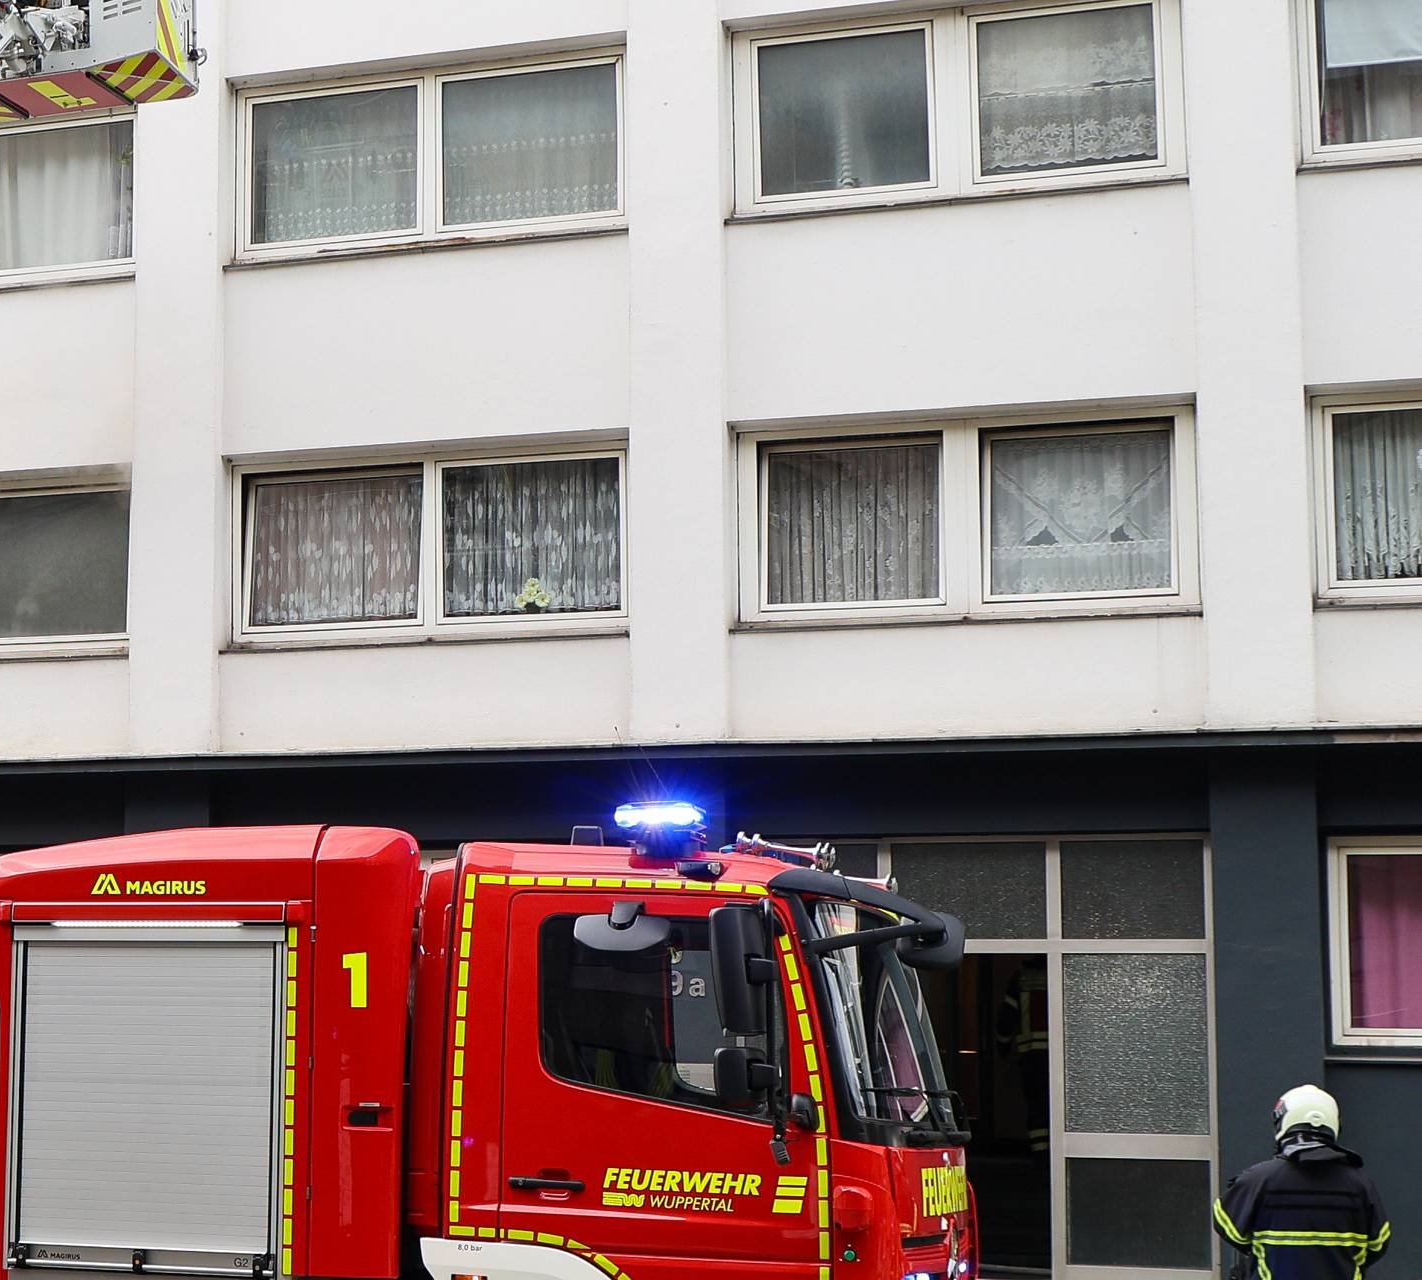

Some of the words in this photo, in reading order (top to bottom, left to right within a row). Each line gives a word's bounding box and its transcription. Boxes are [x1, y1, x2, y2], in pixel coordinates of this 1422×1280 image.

[126, 881, 206, 895] MAGIRUS
[343, 952, 367, 1008] 1
[603, 1167, 762, 1196] FEUERWEHR
[650, 1195, 734, 1212] WUPPERTAL
[458, 1243, 469, 1252] 8,0
[470, 1244, 482, 1252] bar
[50, 1252, 81, 1260] MAGIRUS
[234, 1257, 248, 1268] G2
